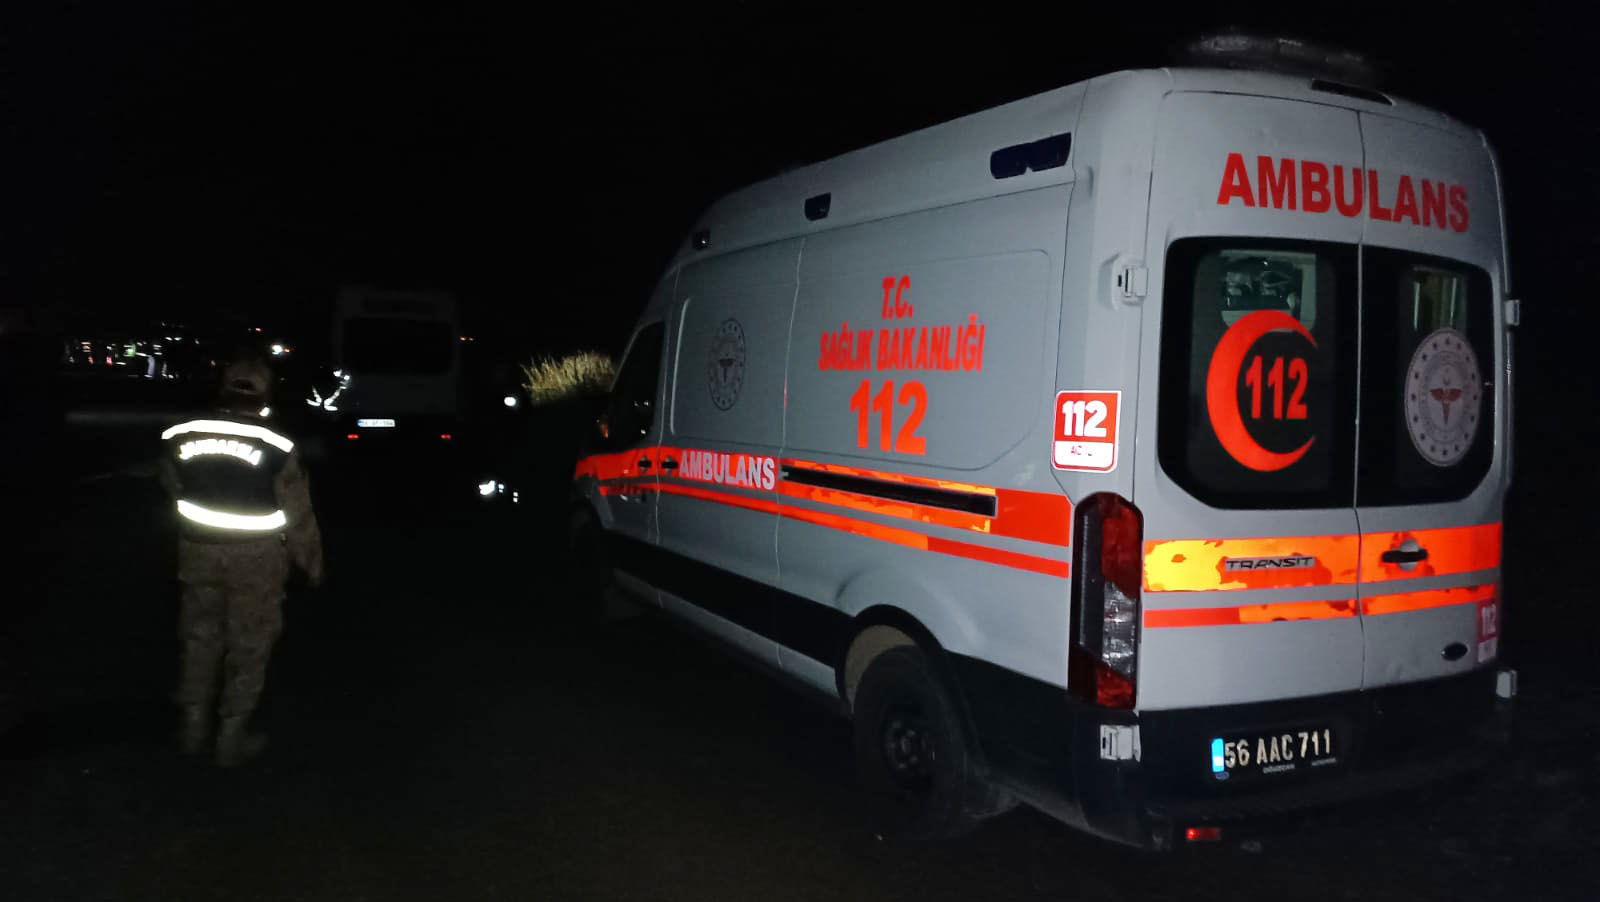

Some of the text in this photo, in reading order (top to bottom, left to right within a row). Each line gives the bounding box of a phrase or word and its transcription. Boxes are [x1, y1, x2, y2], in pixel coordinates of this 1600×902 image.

[1217, 153, 1469, 232] AMBULANS
[882, 275, 914, 319] T.C.
[818, 313, 985, 371] SAĞLIK BAKANLIĞI
[1246, 356, 1308, 420] 112
[851, 380, 928, 455] 112
[1062, 400, 1107, 437] 112
[680, 450, 775, 490] AMBULANS
[1226, 557, 1313, 569] TRANSIT
[1225, 729, 1330, 768] 56 AAC 711
